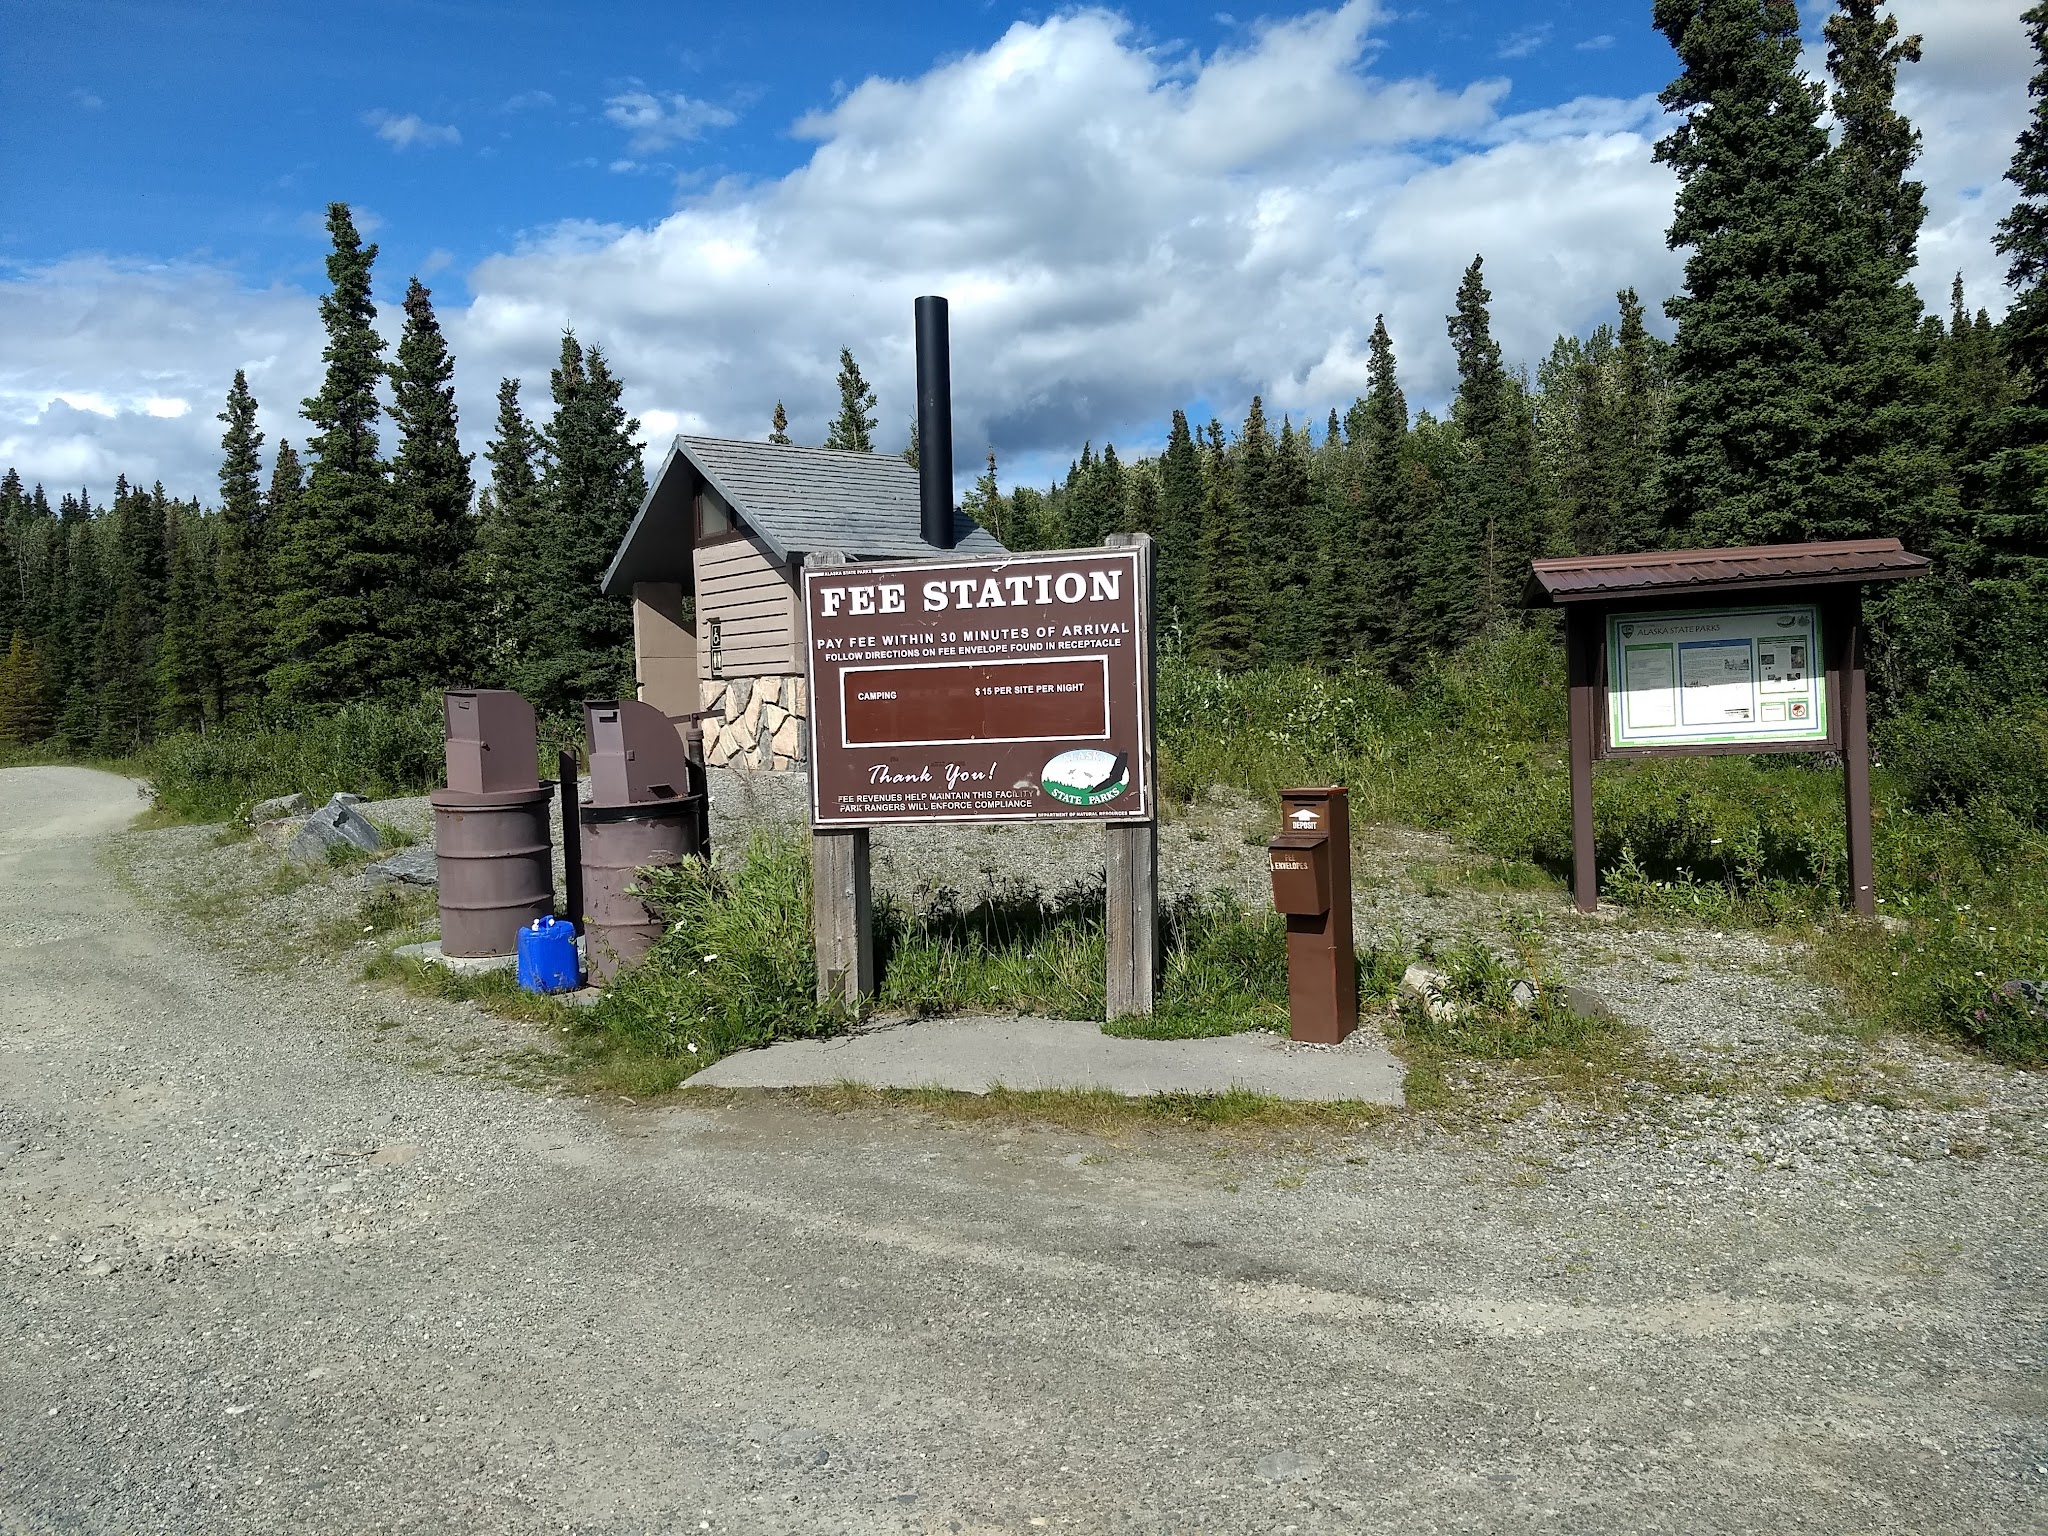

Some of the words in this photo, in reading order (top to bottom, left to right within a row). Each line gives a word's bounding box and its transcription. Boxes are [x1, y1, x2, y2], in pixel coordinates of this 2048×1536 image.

[820, 584, 906, 617] FEE
[923, 570, 1122, 612] STATION
[817, 639, 843, 649] PAY
[850, 637, 876, 648] FEE
[882, 634, 934, 646] WITHIN
[941, 632, 956, 643] 30
[964, 628, 1029, 641] MINUTES
[1036, 626, 1055, 638] OF
[1062, 623, 1129, 636] ARRIVAL
[1637, 627, 1668, 635] ALASKA
[1670, 626, 1693, 634] STATE
[826, 652, 863, 661] FOLLOW
[866, 650, 920, 660] DIRECTIONS
[922, 648, 936, 656] ON
[938, 647, 956, 656] FEE
[959, 645, 1007, 655] ENVELOPE
[1010, 642, 1042, 652] FOUND
[1046, 641, 1055, 650] IN
[1058, 639, 1121, 649] RECEPTACLE
[994, 686, 1012, 695] PER
[1014, 685, 1034, 694] SITE
[1036, 684, 1054, 694] PER
[1056, 683, 1084, 692] NIGHT
[858, 691, 897, 701] CAMPING
[1064, 752, 1108, 761] ALASKA
[868, 764, 933, 785] Thank
[945, 761, 998, 790] You!
[838, 795, 854, 803] FEE
[857, 794, 903, 803] REVENUES
[905, 793, 927, 801] HELP
[929, 792, 970, 801] MAINTAIN
[972, 791, 992, 799] THIS
[995, 790, 1034, 798] FACILITY
[1051, 788, 1082, 804] STATE
[1089, 788, 1120, 804] PARKS
[839, 804, 862, 813] PARK
[864, 804, 906, 812] RANGERS
[930, 801, 972, 810] ENFORCE
[974, 800, 1032, 809] COMPLIANCE
[1275, 862, 1308, 870] ENVELOPES
